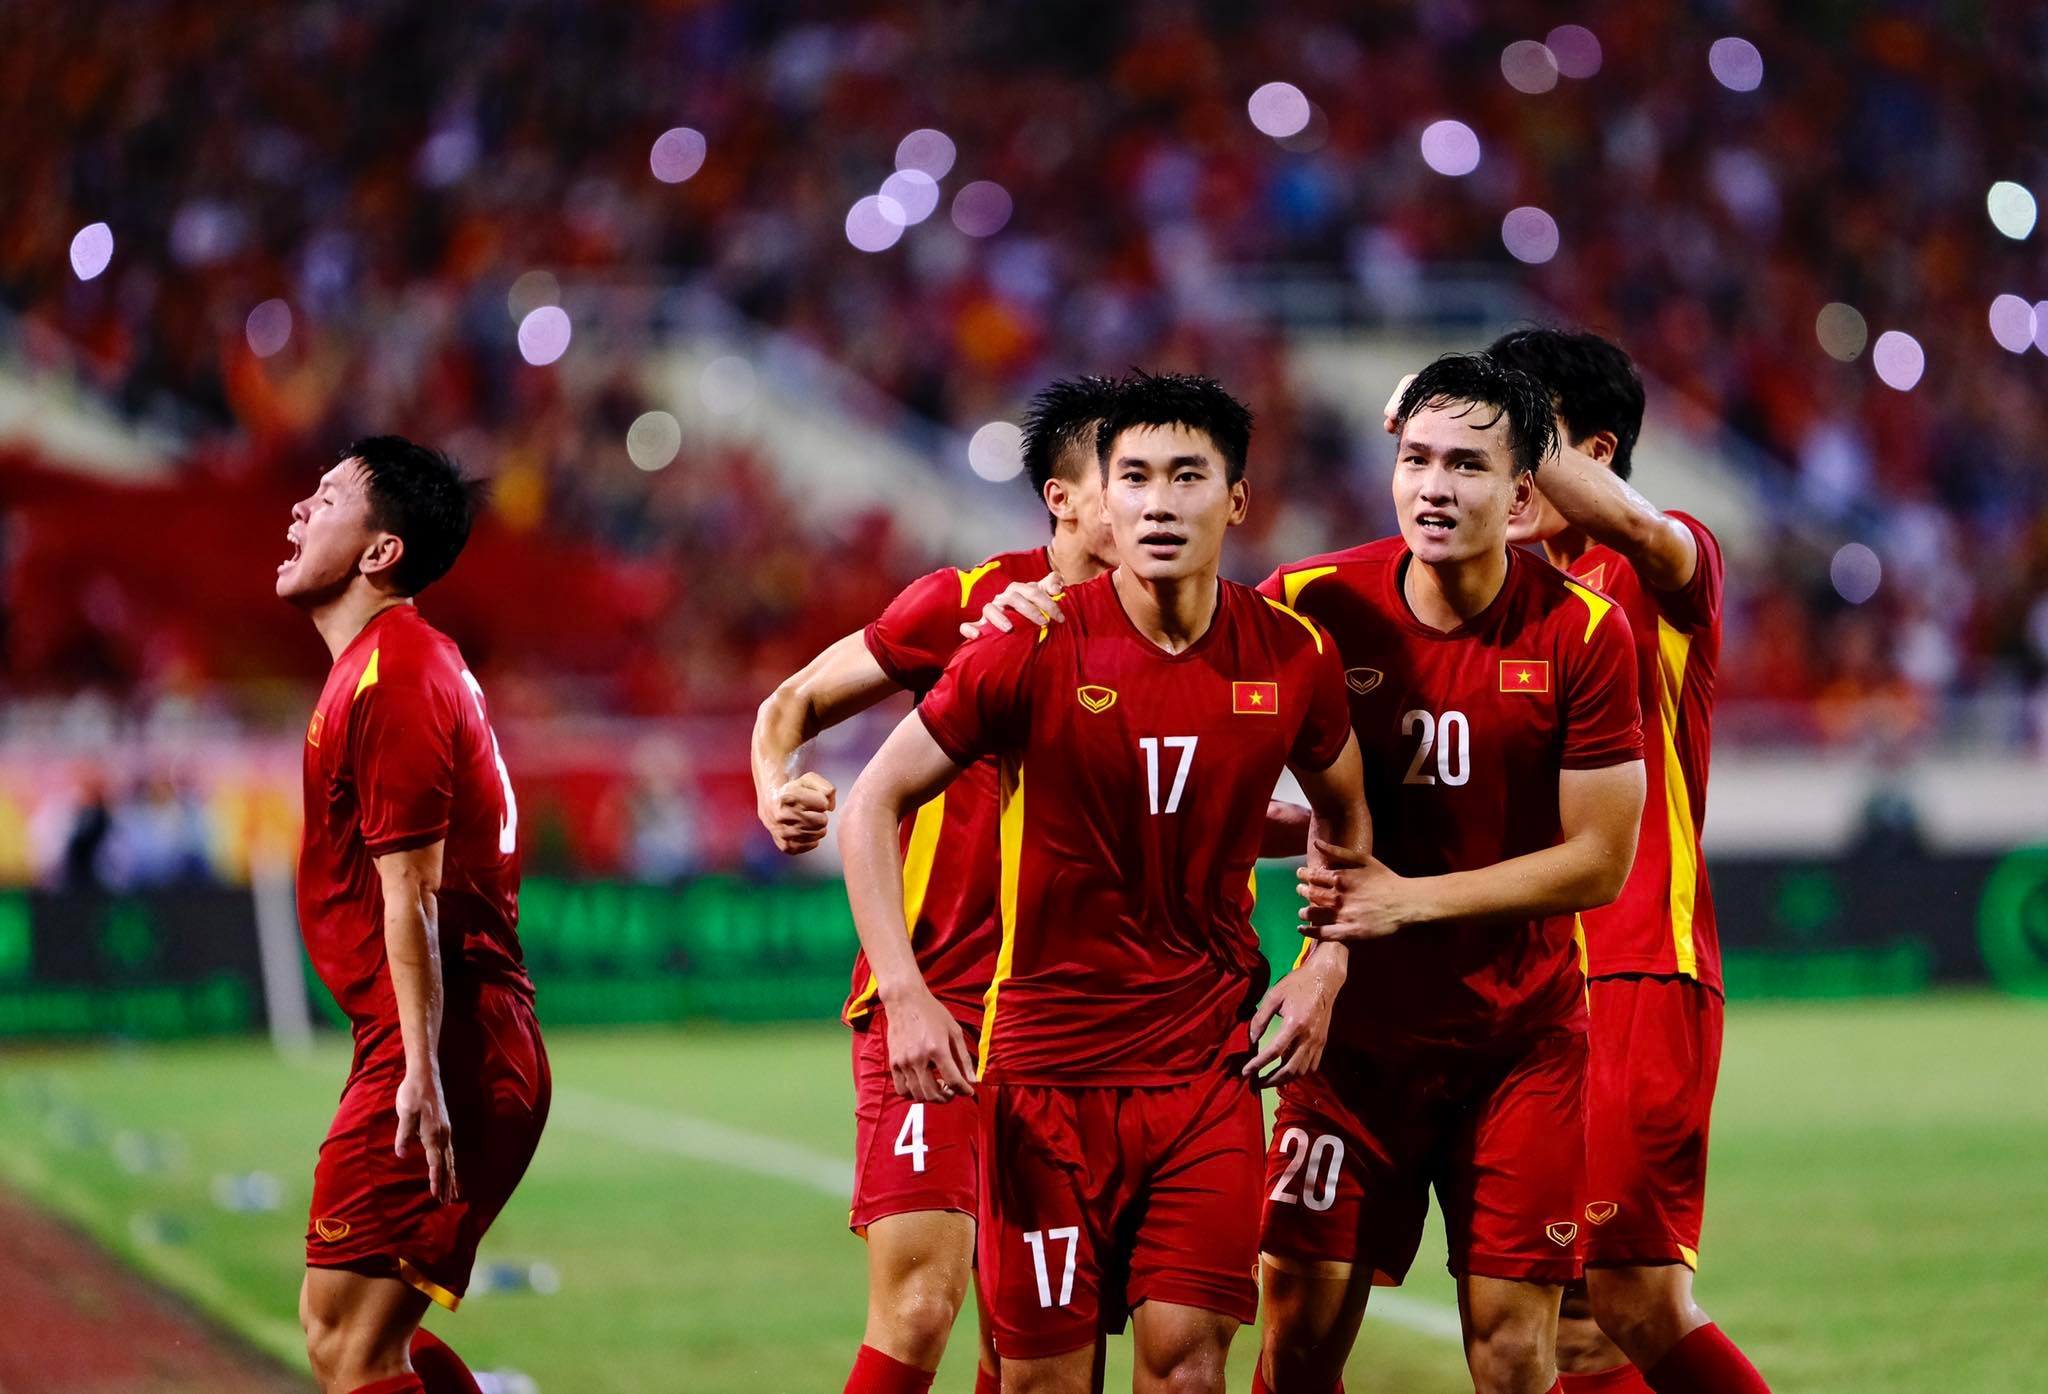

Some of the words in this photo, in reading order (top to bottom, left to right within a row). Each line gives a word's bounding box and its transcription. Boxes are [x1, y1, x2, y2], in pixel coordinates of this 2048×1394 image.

[1139, 736, 1198, 815] 17
[1402, 710, 1471, 786] 20
[894, 1103, 928, 1172] 4
[1269, 1127, 1344, 1210] 20
[1023, 1226, 1080, 1307] 17
